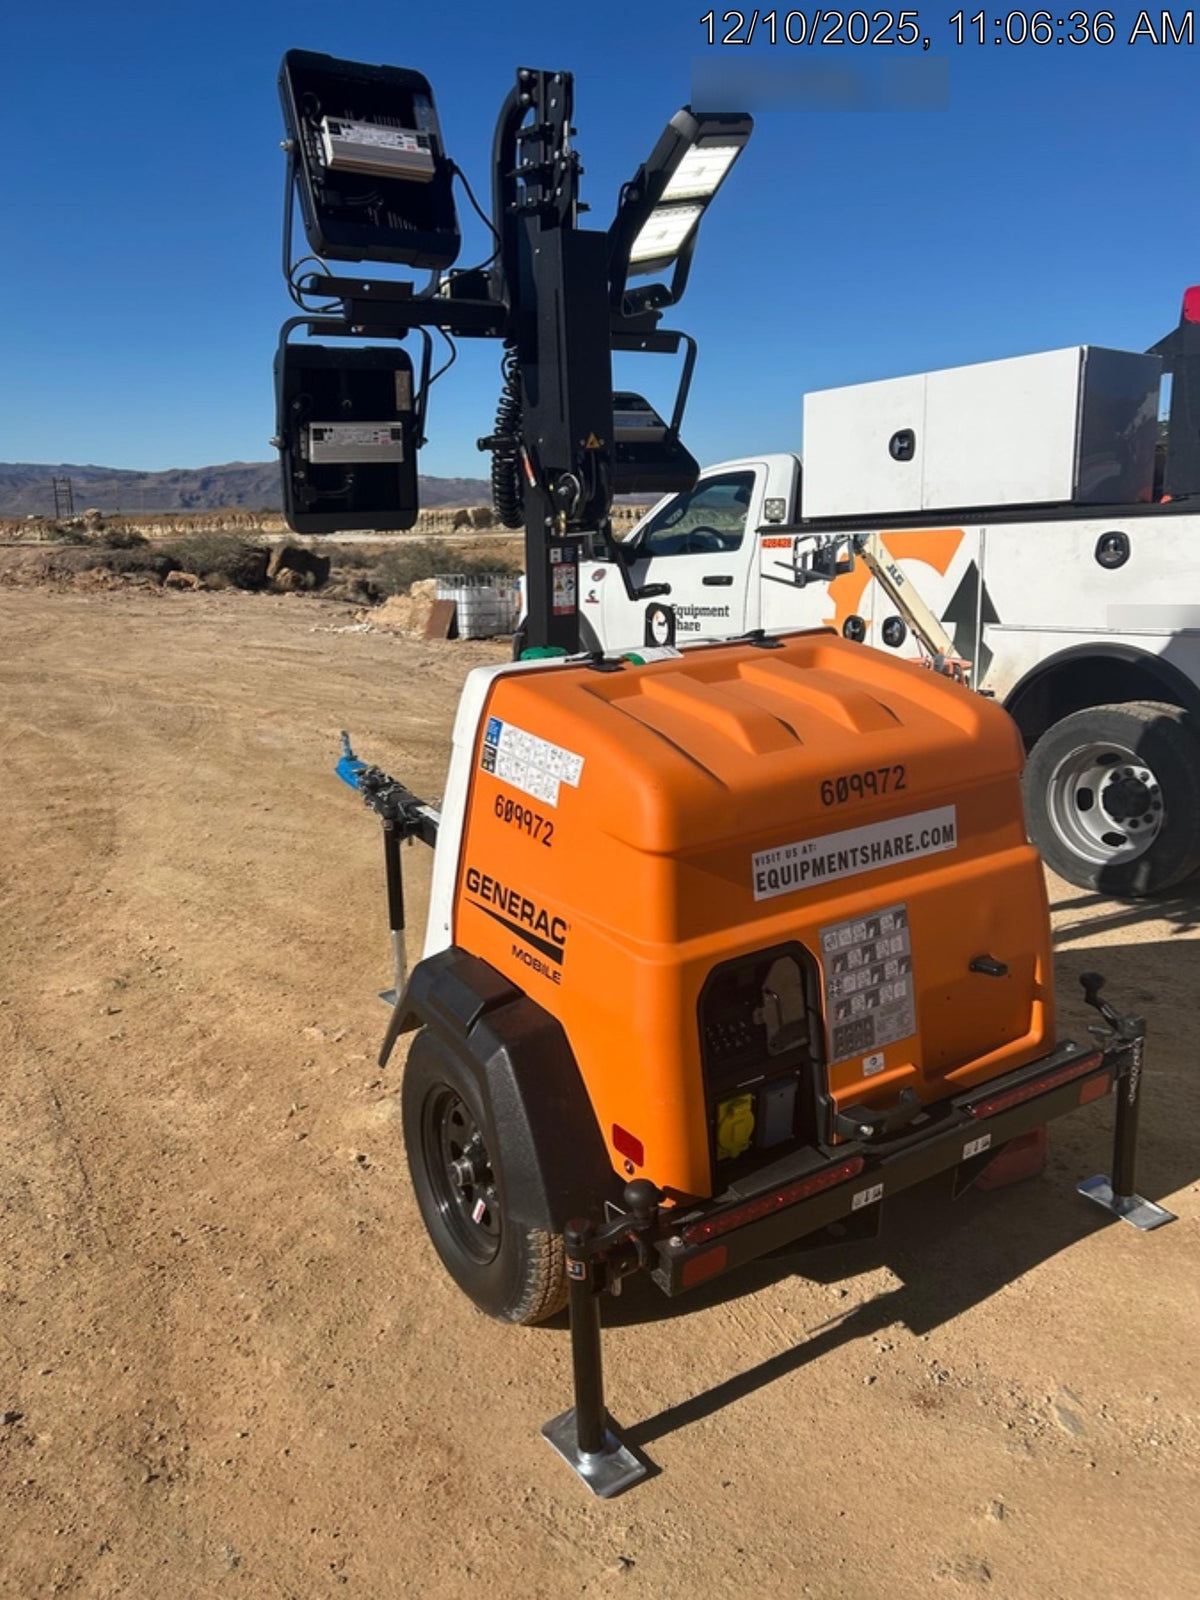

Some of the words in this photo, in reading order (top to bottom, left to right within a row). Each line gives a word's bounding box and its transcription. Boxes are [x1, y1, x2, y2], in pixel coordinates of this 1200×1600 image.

[676, 618, 702, 632] hare
[820, 764, 907, 806] 609972
[494, 794, 554, 847] 609972
[755, 851, 781, 867] VISIT
[785, 847, 798, 860] US
[801, 843, 817, 855] AT:
[756, 823, 955, 892] EQUIPMENTSHARE.COM
[466, 867, 568, 946] GENERAC
[511, 944, 563, 986] MOBILE
